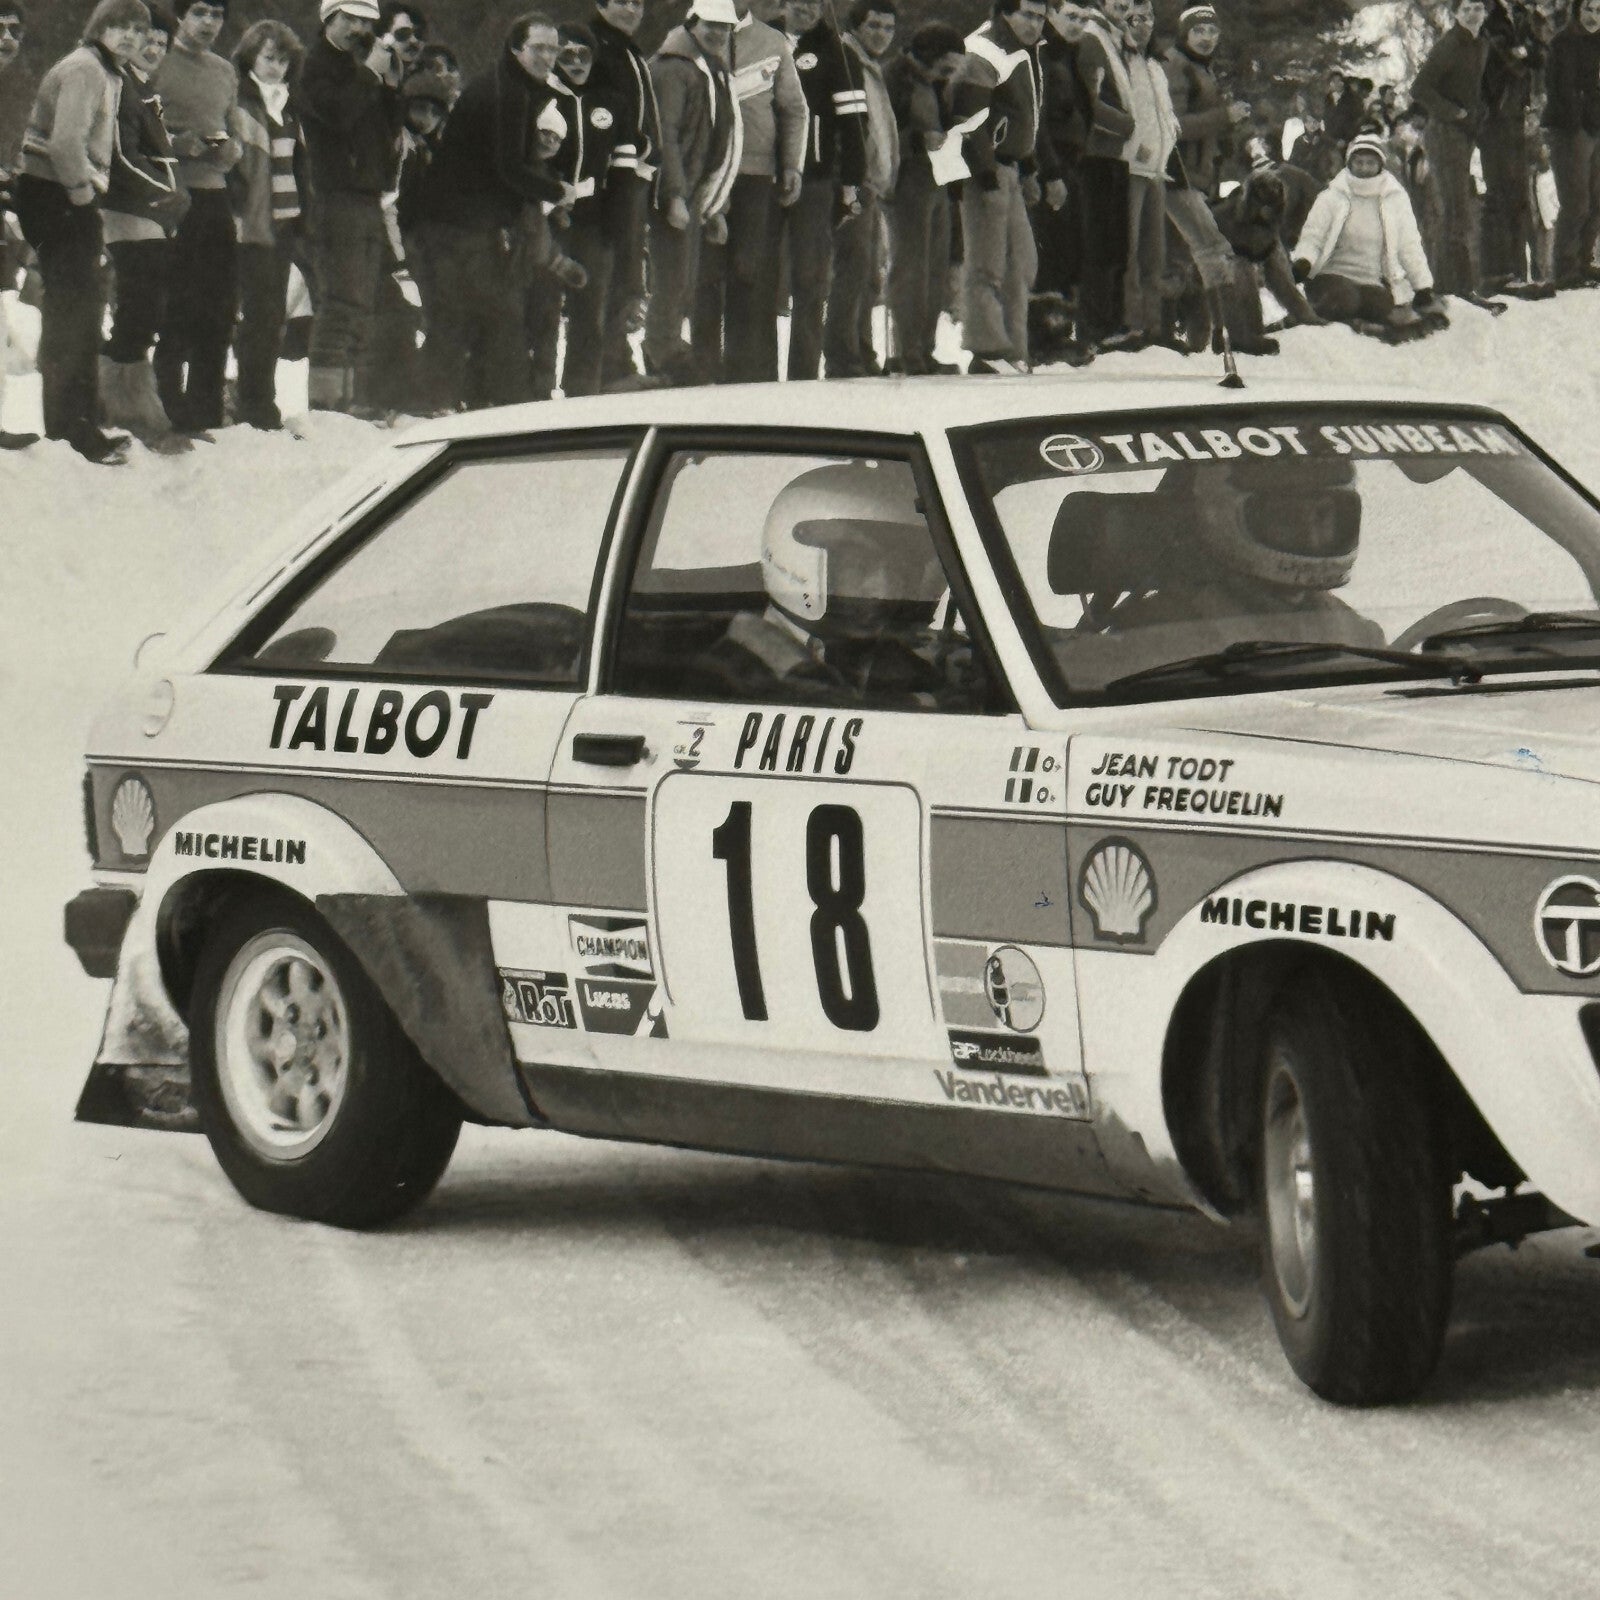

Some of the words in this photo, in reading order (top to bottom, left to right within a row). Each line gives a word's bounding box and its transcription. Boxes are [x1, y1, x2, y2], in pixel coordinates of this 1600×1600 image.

[1105, 426, 1309, 464] TALBOT
[1319, 424, 1519, 456] SUNBEAM
[269, 684, 496, 760] TALBOT
[733, 711, 864, 775] PARIS
[1091, 752, 1160, 779] JEAN
[1167, 755, 1235, 783] TODT
[1085, 782, 1136, 808] GUY
[1142, 785, 1285, 818] FREQUELIN
[174, 831, 307, 865] MICHELIN
[712, 800, 880, 1032] 18
[1200, 897, 1397, 942] MICHELIN
[576, 935, 648, 961] CHAMPION
